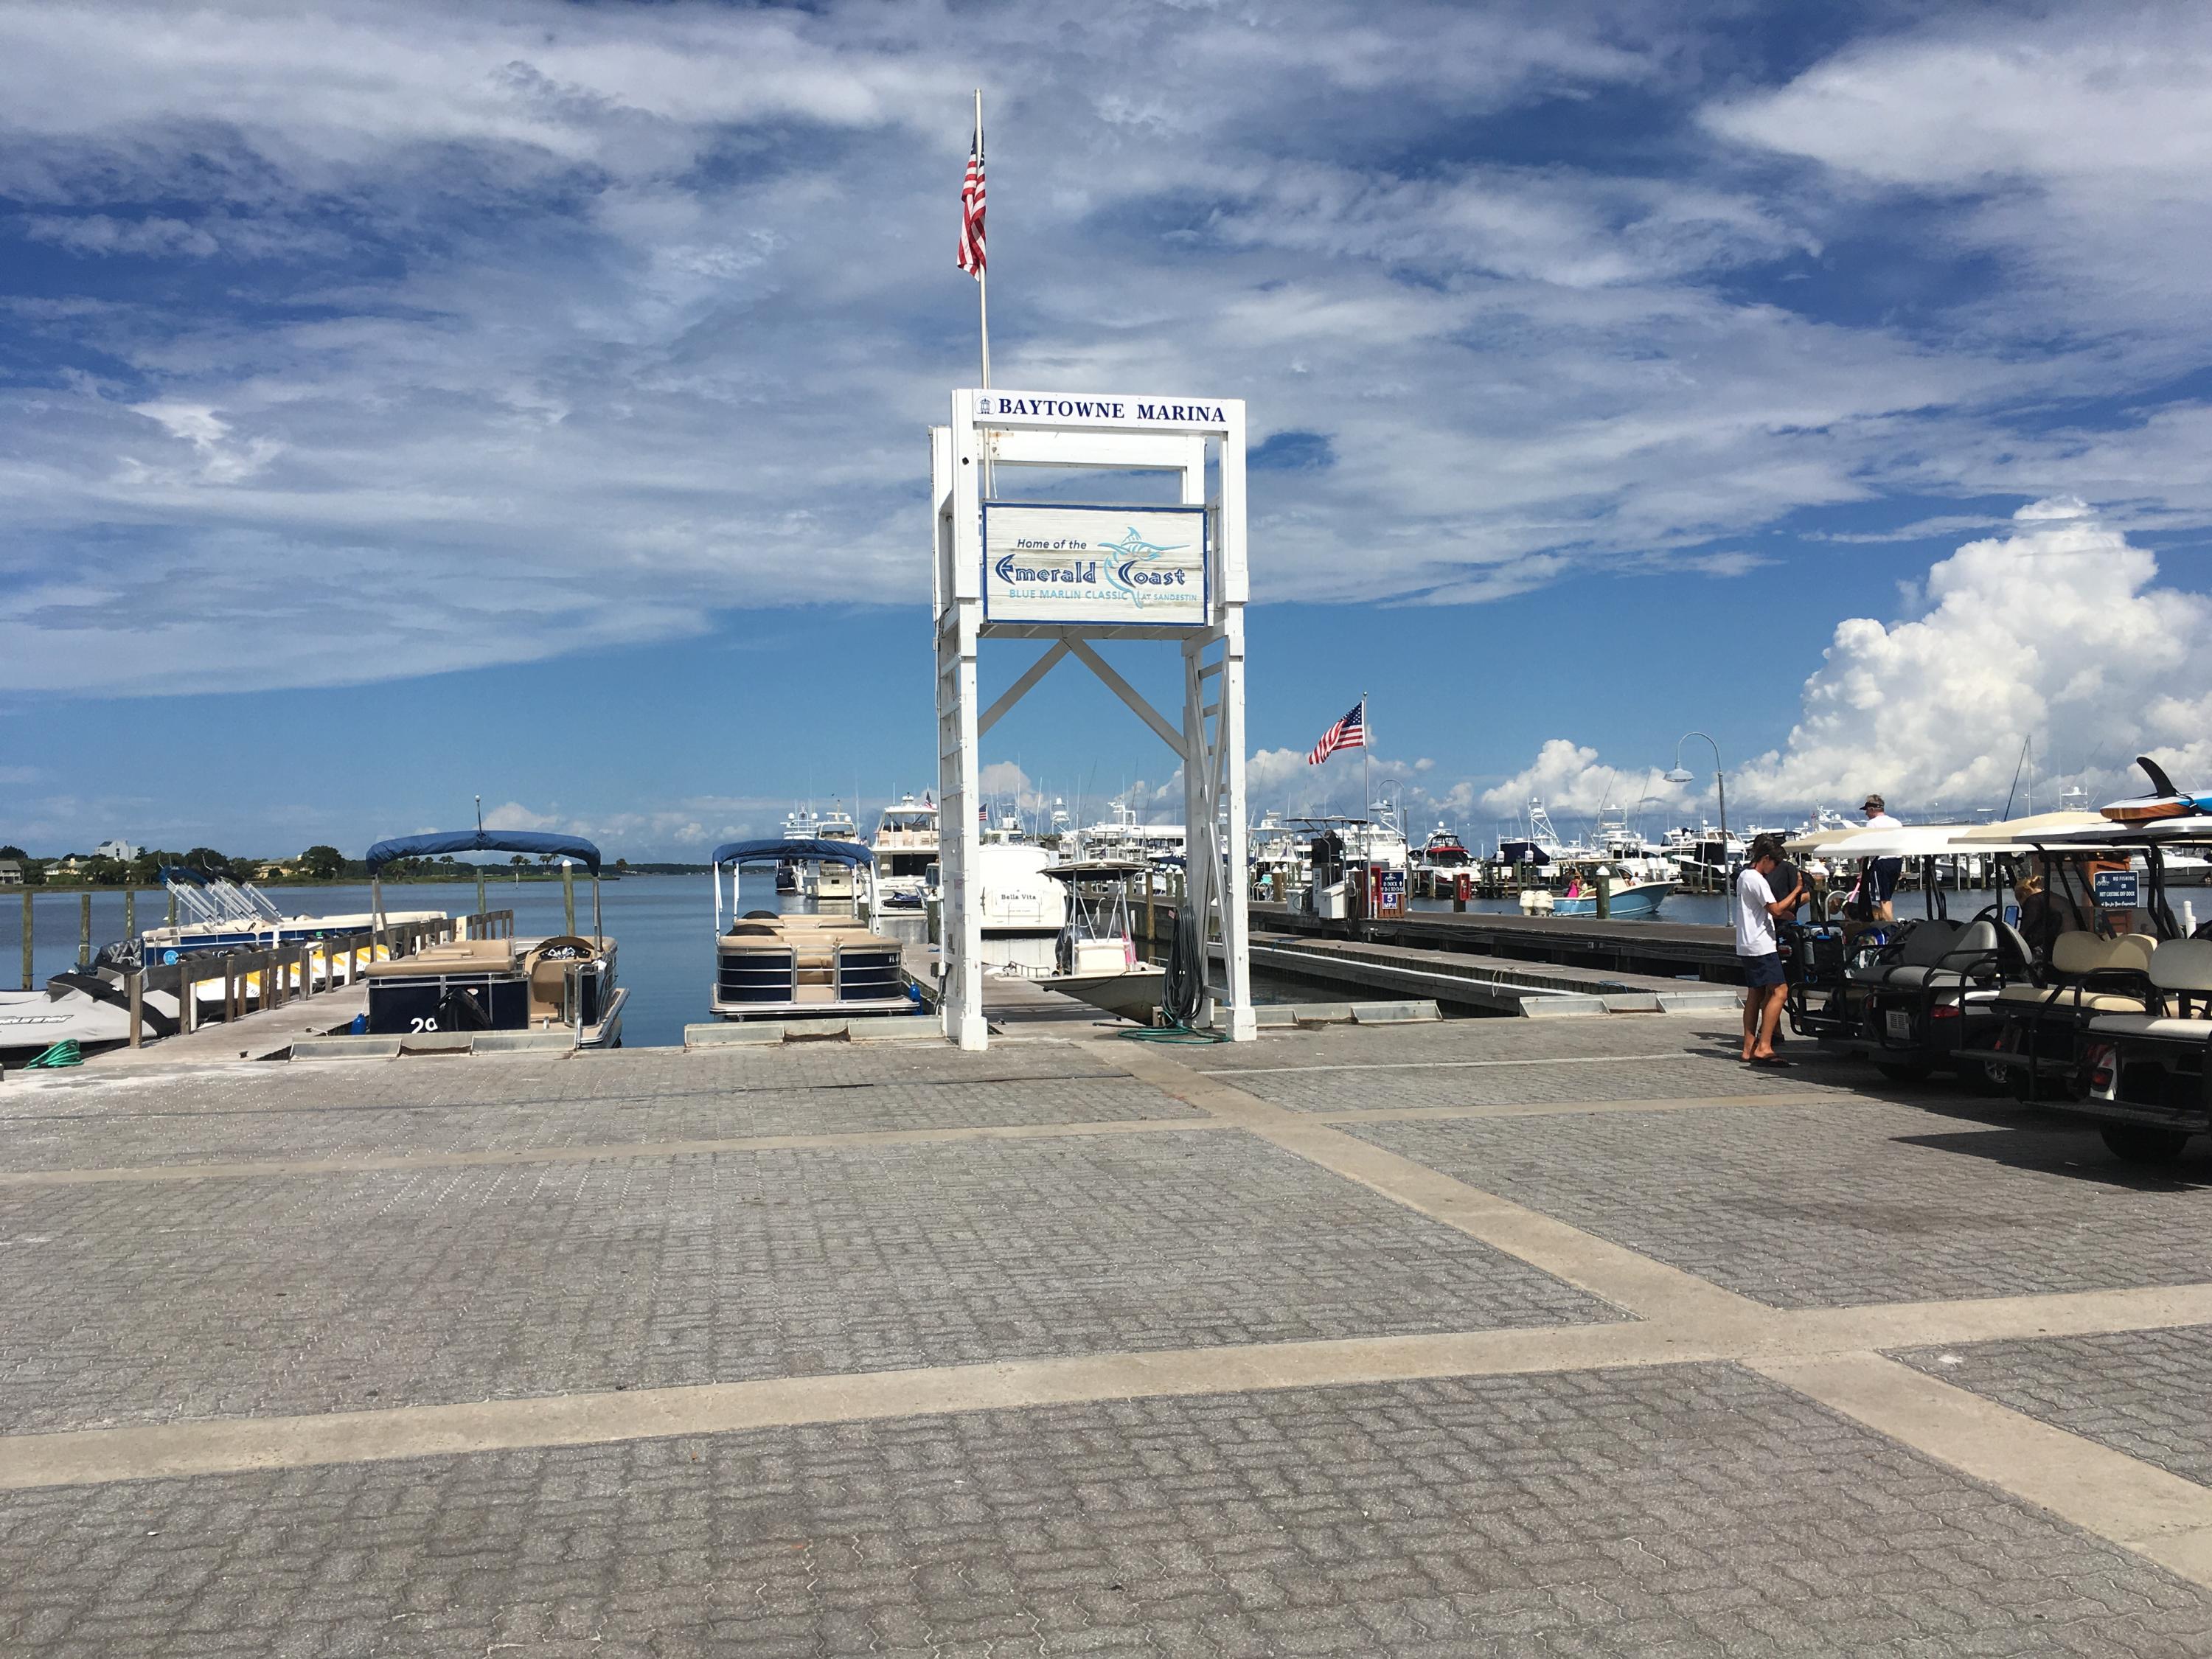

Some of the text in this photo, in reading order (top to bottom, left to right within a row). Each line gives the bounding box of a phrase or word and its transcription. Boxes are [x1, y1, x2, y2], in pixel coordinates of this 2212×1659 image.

[998, 398, 1225, 422] BAYTOWNE MARINA
[1017, 539, 1087, 549] Home of the
[995, 554, 1185, 588] Emerald Coast
[1009, 589, 1127, 600] BLUE MARLIN CLASSIC
[1153, 594, 1197, 602] SANDESTIN
[1387, 894, 1393, 902] 5
[410, 1018, 439, 1034] 29
